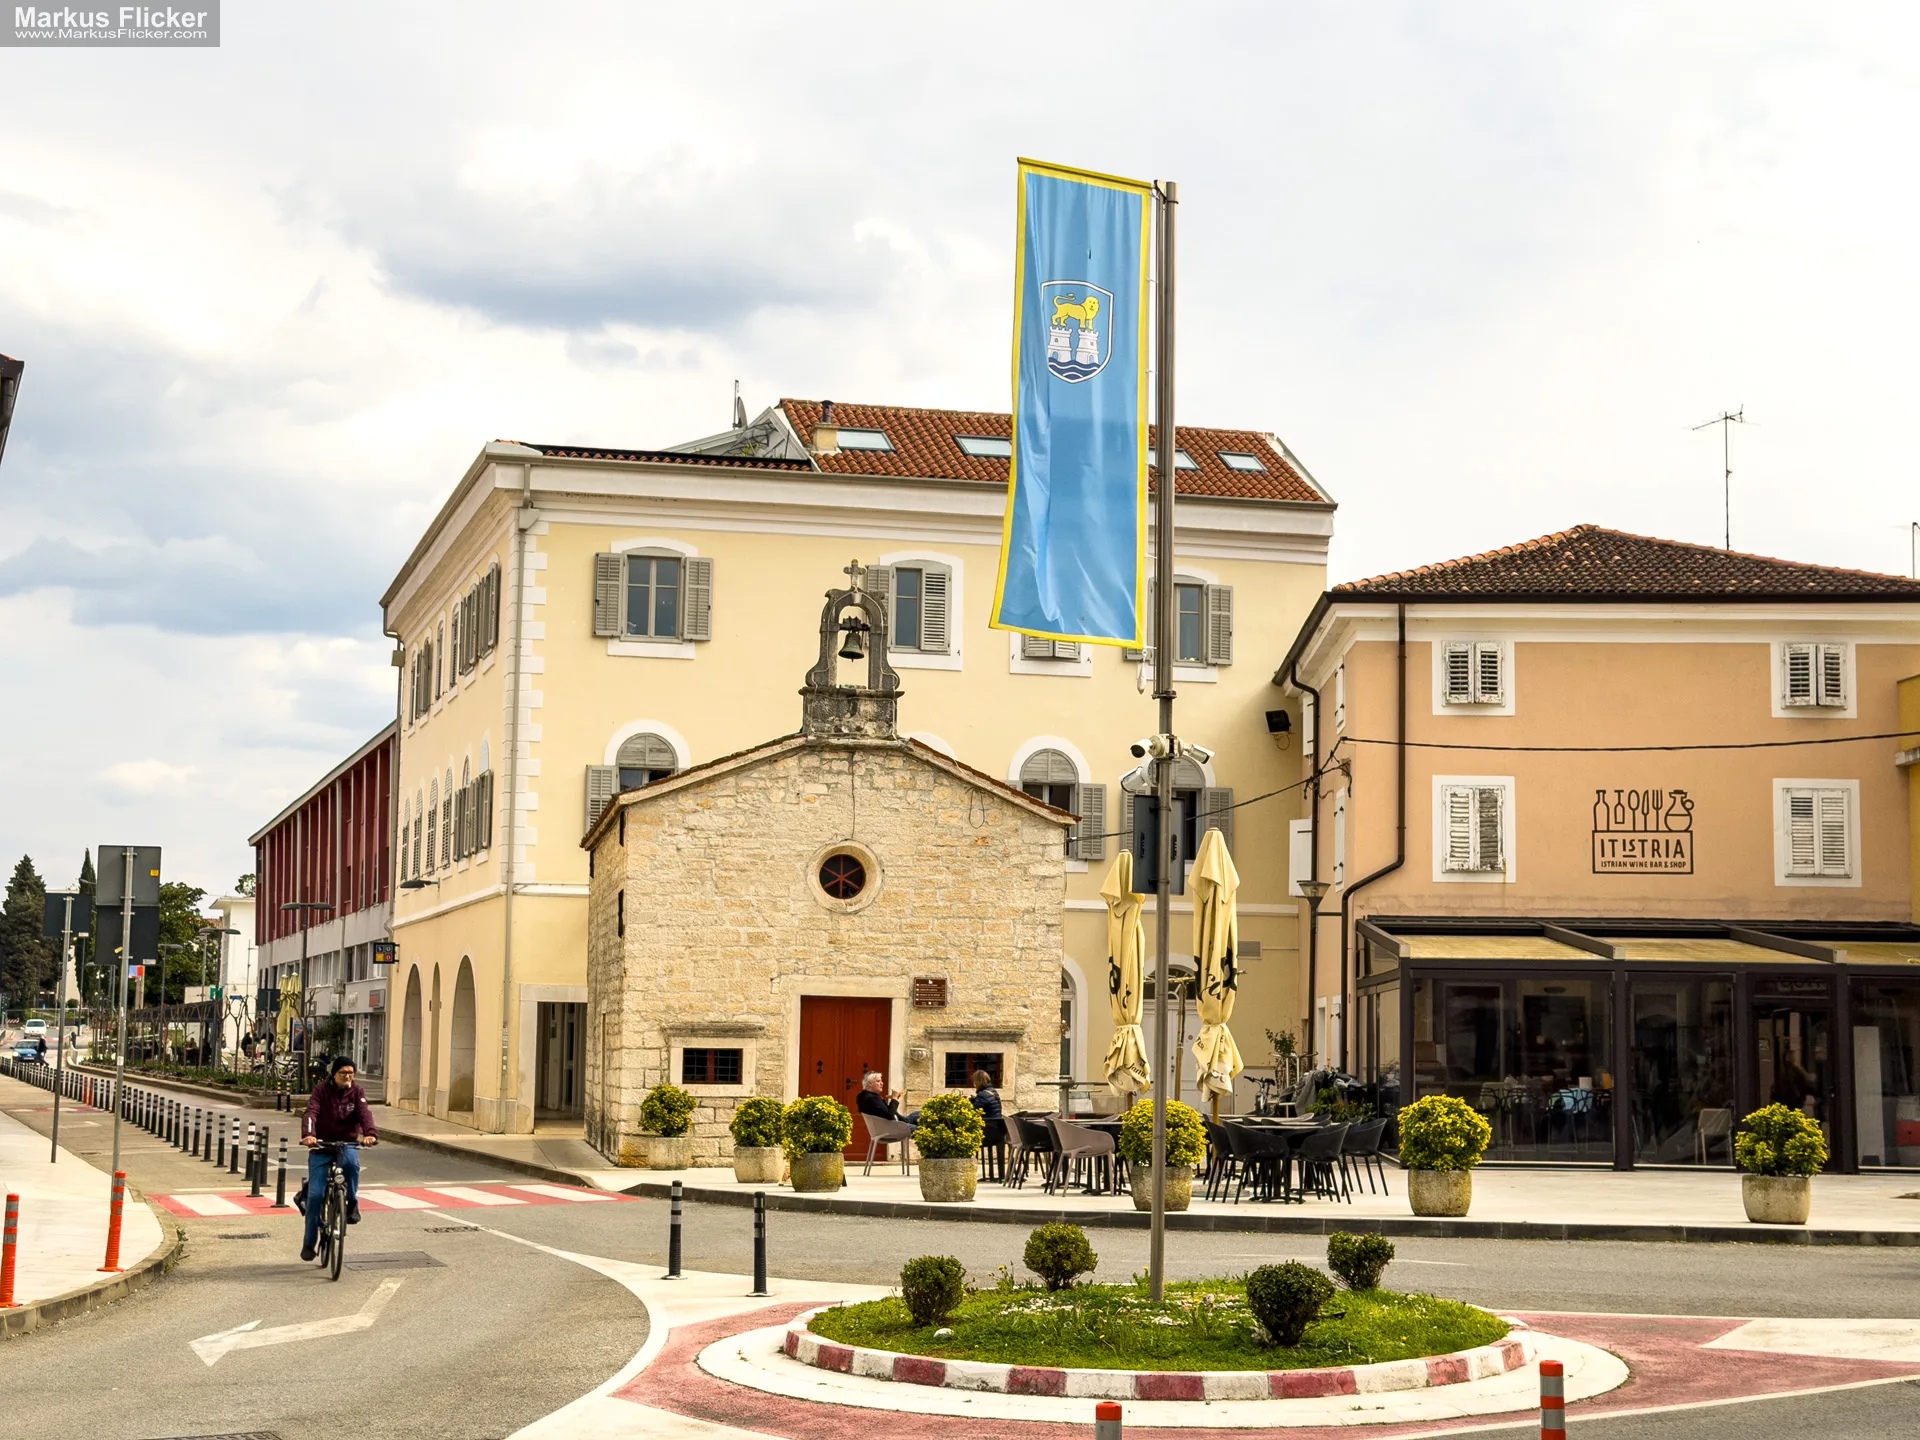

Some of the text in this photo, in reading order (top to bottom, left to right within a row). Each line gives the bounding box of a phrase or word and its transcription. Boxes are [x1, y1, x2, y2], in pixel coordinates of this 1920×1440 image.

[1600, 860, 1687, 869] ISTRIAN WINE BAR & SHOP
